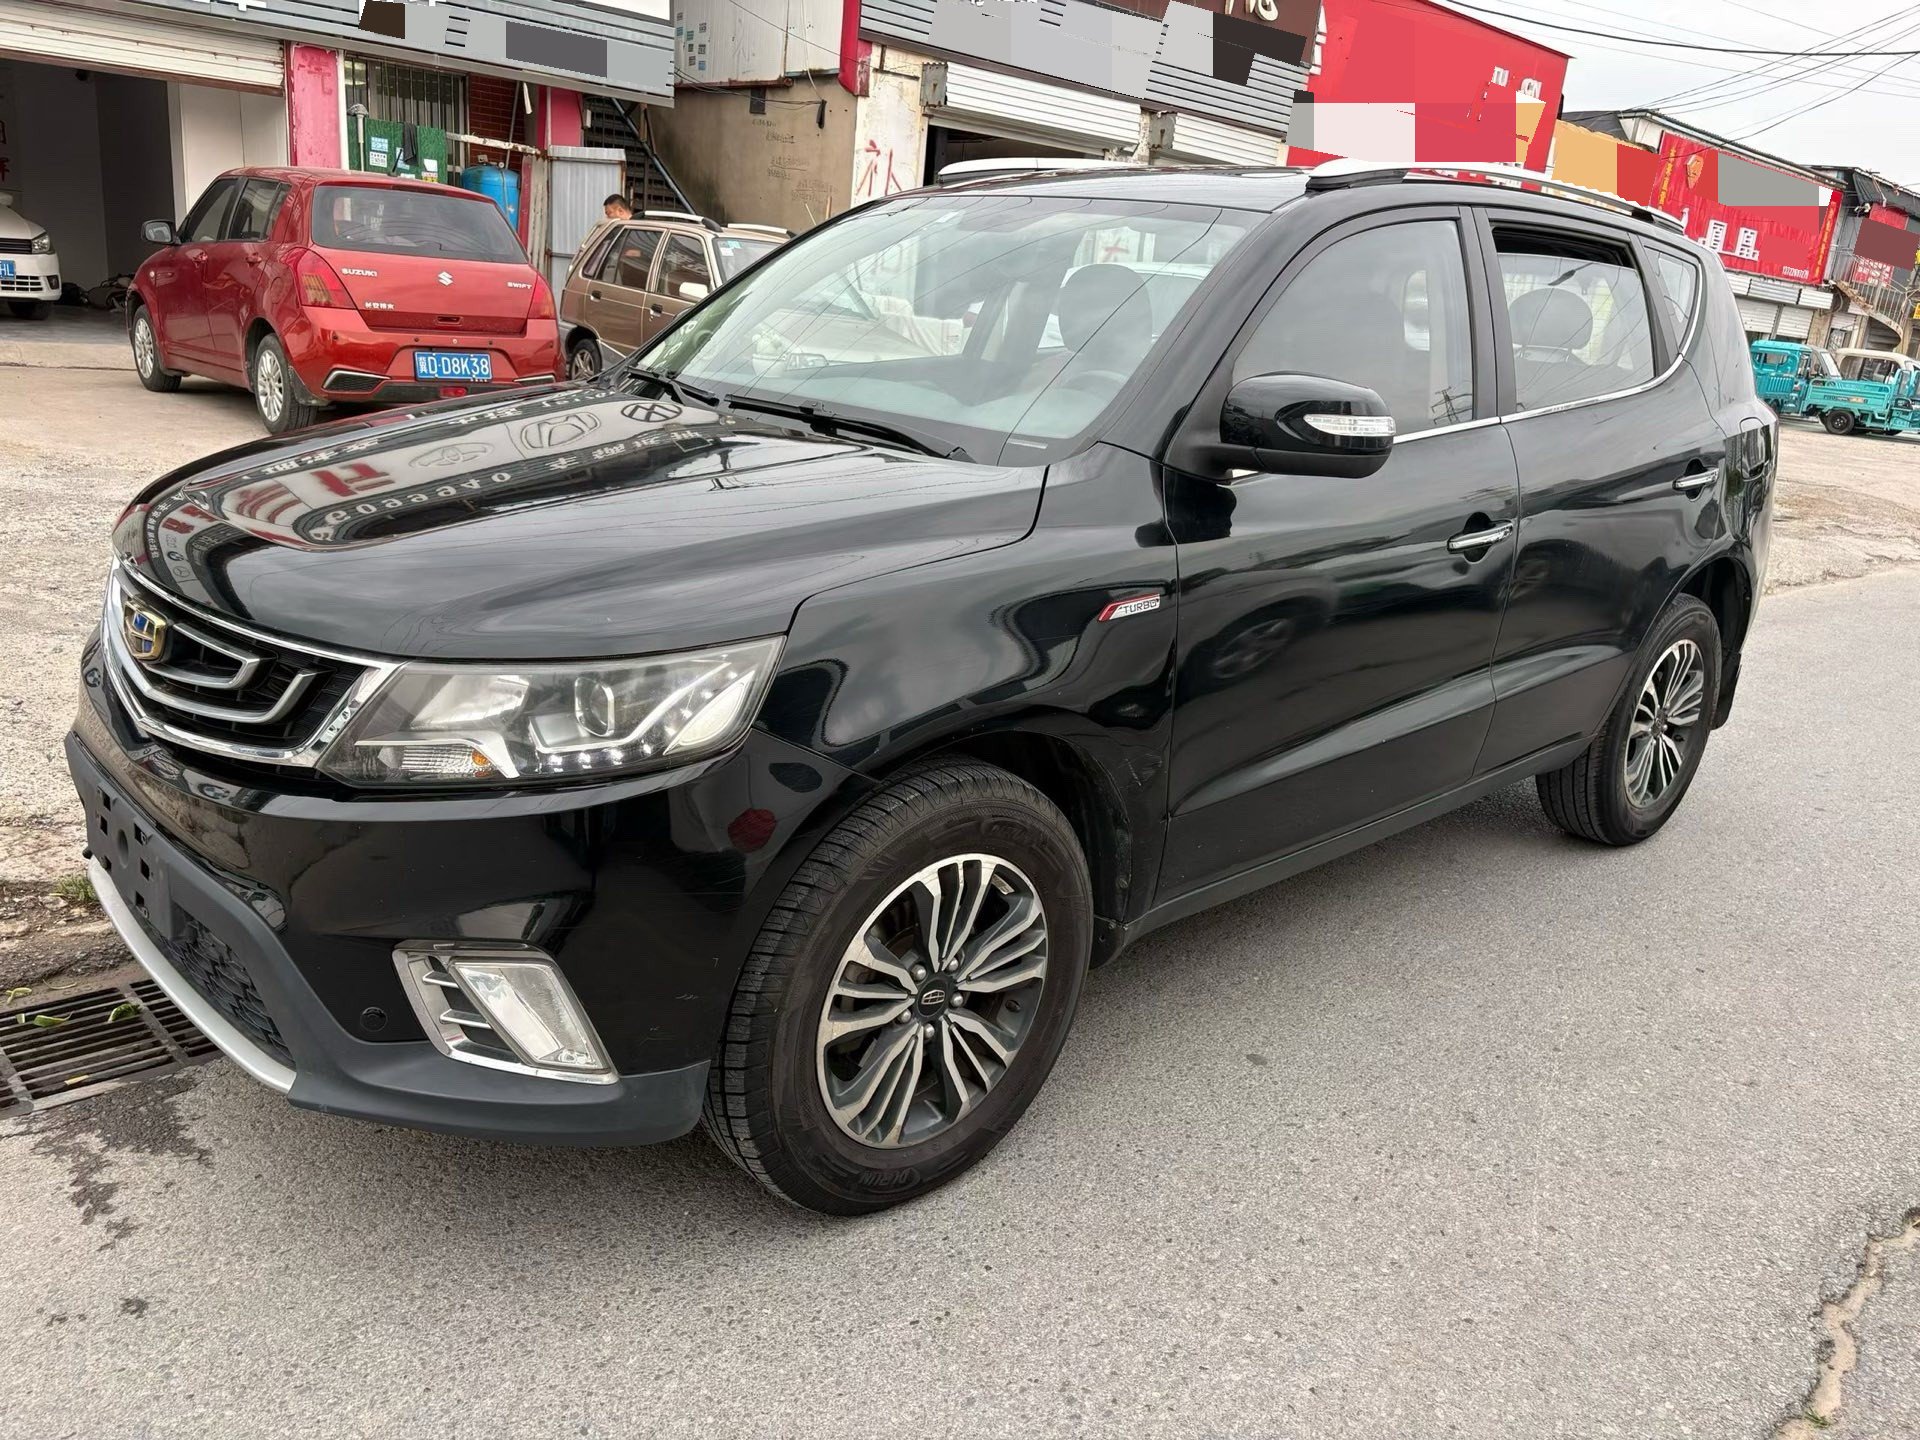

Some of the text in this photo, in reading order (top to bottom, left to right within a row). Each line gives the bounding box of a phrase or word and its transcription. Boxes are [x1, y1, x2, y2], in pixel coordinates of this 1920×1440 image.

[341, 268, 378, 277] SUZUKI
[507, 281, 532, 290] SWIFT
[1123, 600, 1157, 614] TURBO
